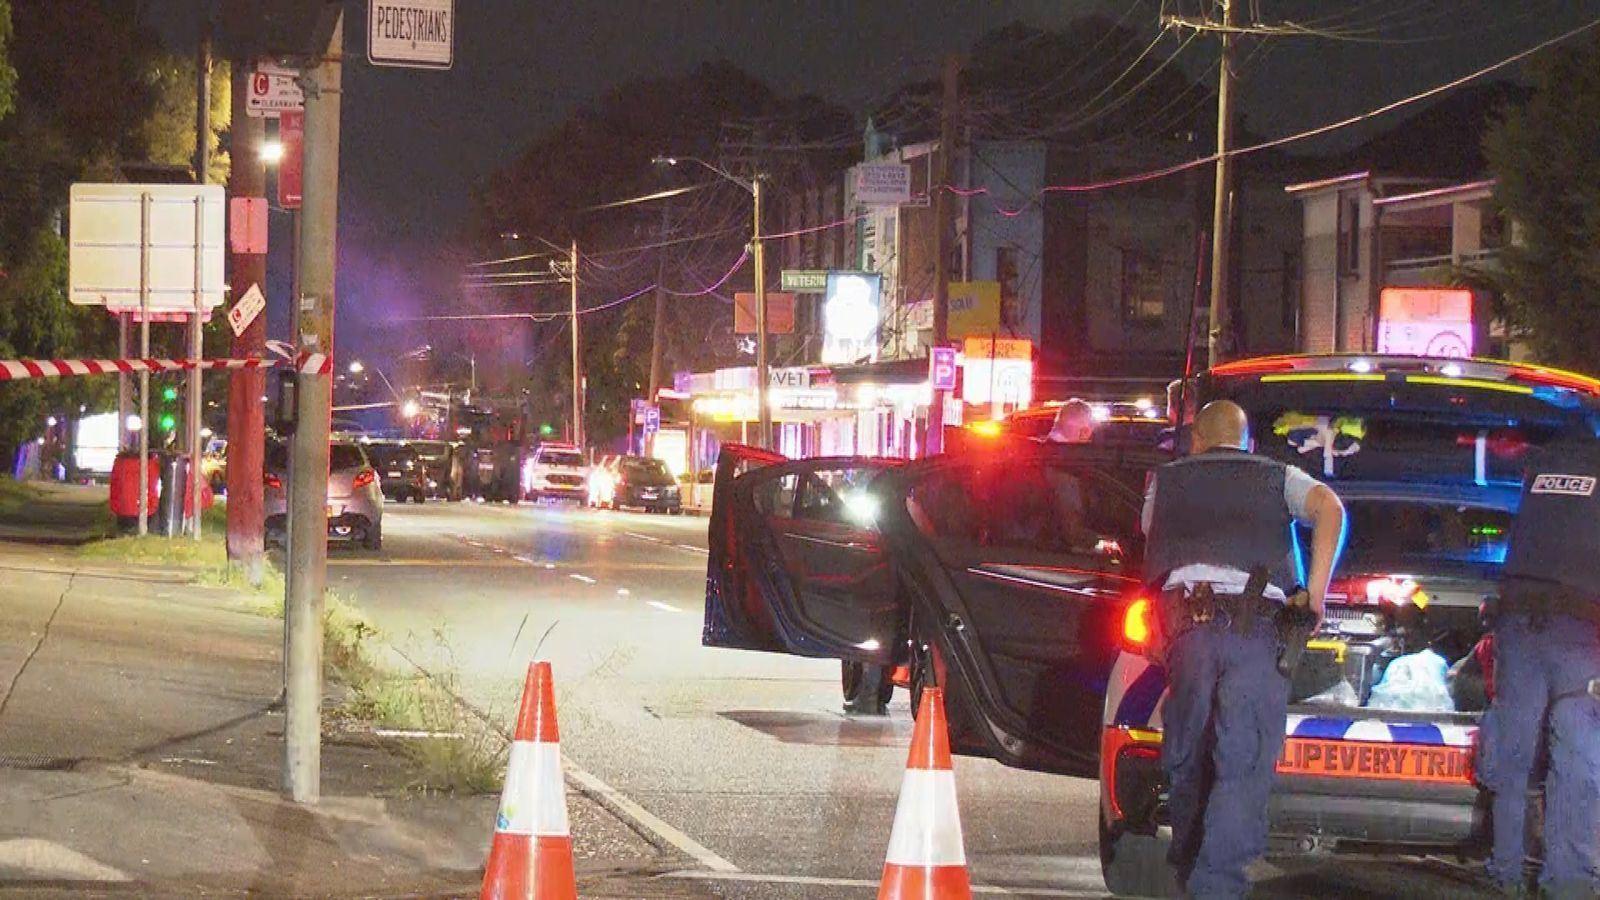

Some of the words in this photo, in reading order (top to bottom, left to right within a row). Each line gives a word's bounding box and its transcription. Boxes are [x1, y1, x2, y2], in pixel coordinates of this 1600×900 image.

[377, 6, 447, 42] PEDESTRIANS
[256, 74, 267, 94] C
[936, 365, 951, 384] P
[647, 411, 658, 424] P
[1535, 477, 1592, 491] POLICE
[1325, 744, 1408, 774] EVERY
